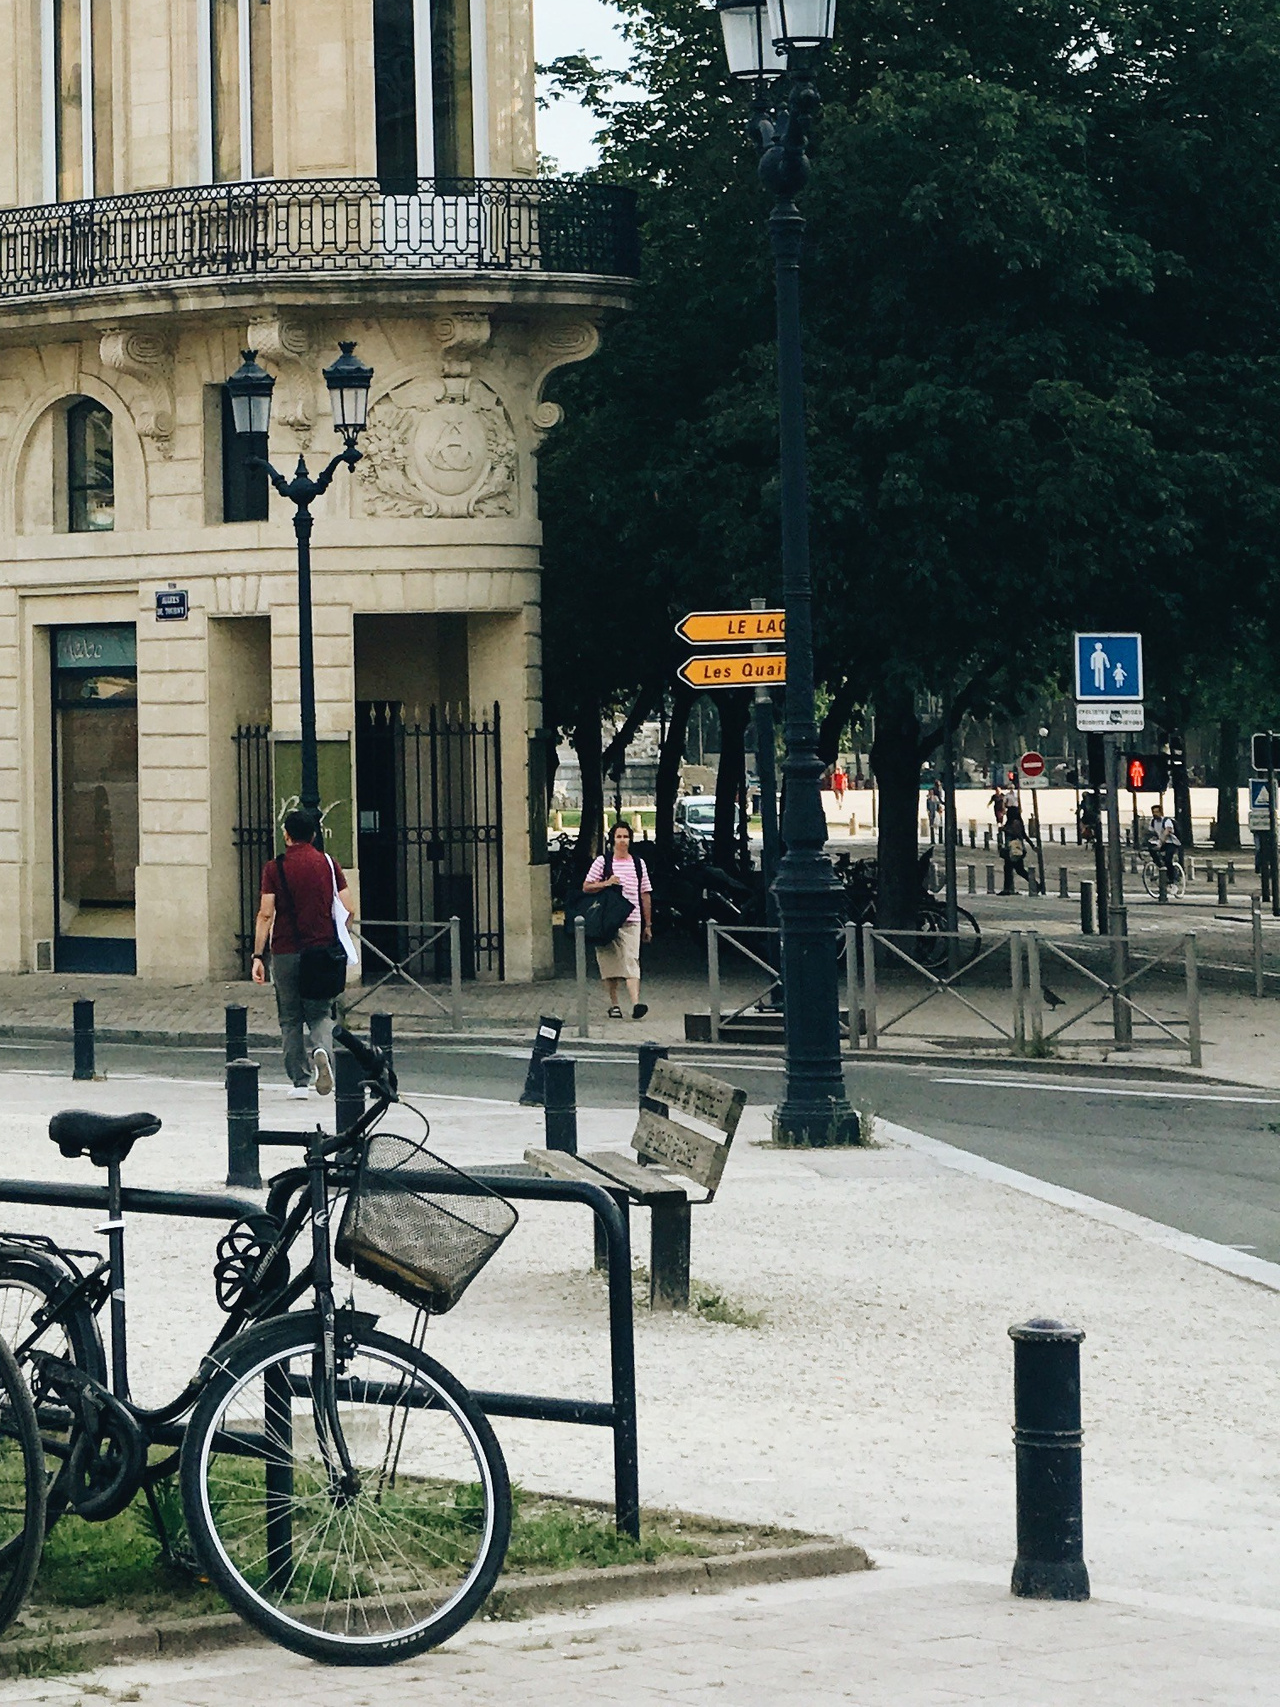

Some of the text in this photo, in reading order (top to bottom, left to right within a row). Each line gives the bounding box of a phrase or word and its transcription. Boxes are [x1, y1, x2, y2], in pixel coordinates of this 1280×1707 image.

[728, 619, 746, 634] LE
[704, 662, 785, 679] Les Quai
